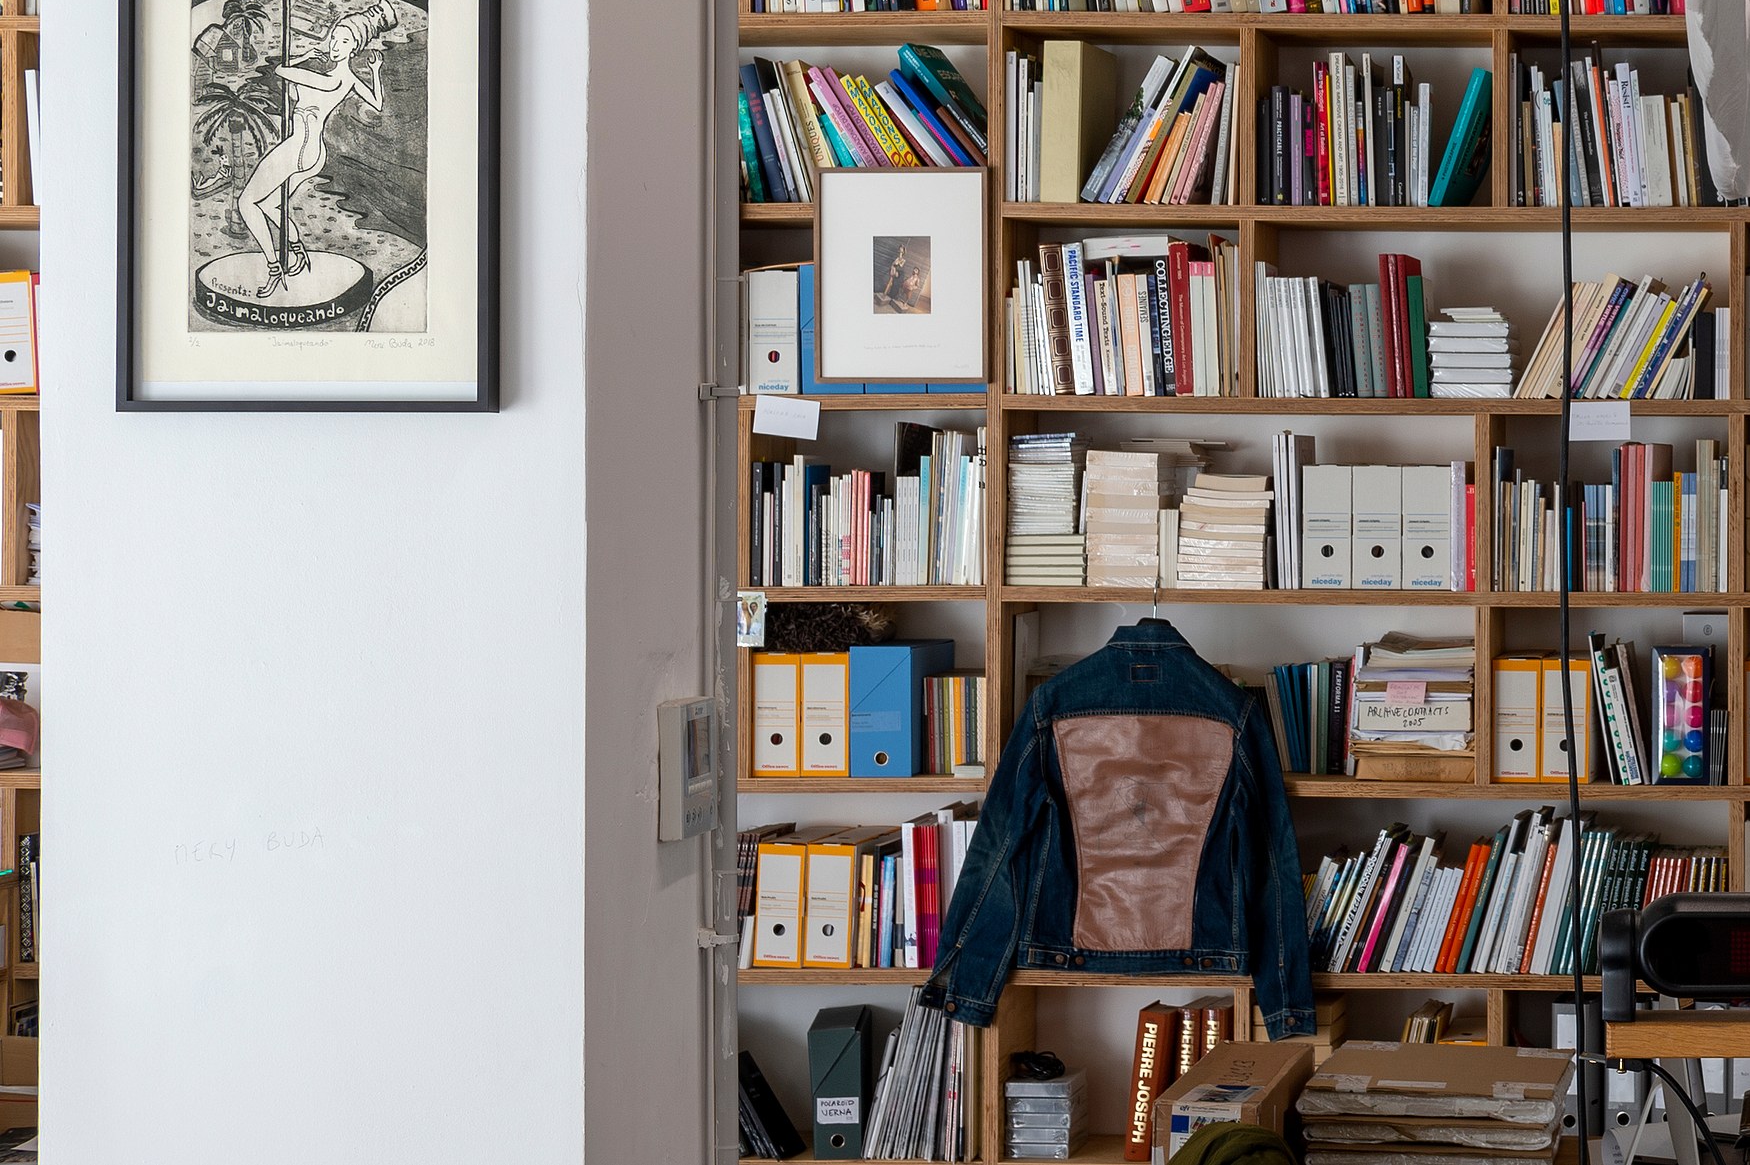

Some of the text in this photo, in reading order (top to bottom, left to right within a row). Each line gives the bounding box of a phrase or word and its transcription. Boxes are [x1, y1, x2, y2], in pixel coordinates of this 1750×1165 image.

[1619, 80, 1631, 109] Resist!
[837, 113, 848, 125] DU
[842, 75, 891, 146] AMAZONS
[852, 113, 863, 124] DU
[804, 119, 825, 162] UNIQUES
[842, 122, 867, 156] AMAZONES
[857, 121, 882, 156] AMAZONES
[1275, 120, 1283, 154] PRACTICABLE
[862, 153, 874, 167] LES
[877, 153, 889, 166] LES
[205, 291, 346, 327] Jaimaloqueando
[1066, 249, 1084, 342] PACIFIC STANDARD TIME
[1137, 290, 1149, 323] SEMAINES
[758, 382, 790, 393] niceday
[1311, 578, 1343, 588] niceday
[1361, 578, 1393, 588] niceday
[1411, 578, 1443, 588] niceday
[1333, 670, 1343, 704] PERFORMA
[266, 825, 328, 853] BUDA
[1130, 1022, 1158, 1143] PIERRE JOSEPH
[821, 1108, 852, 1118] VERNA
